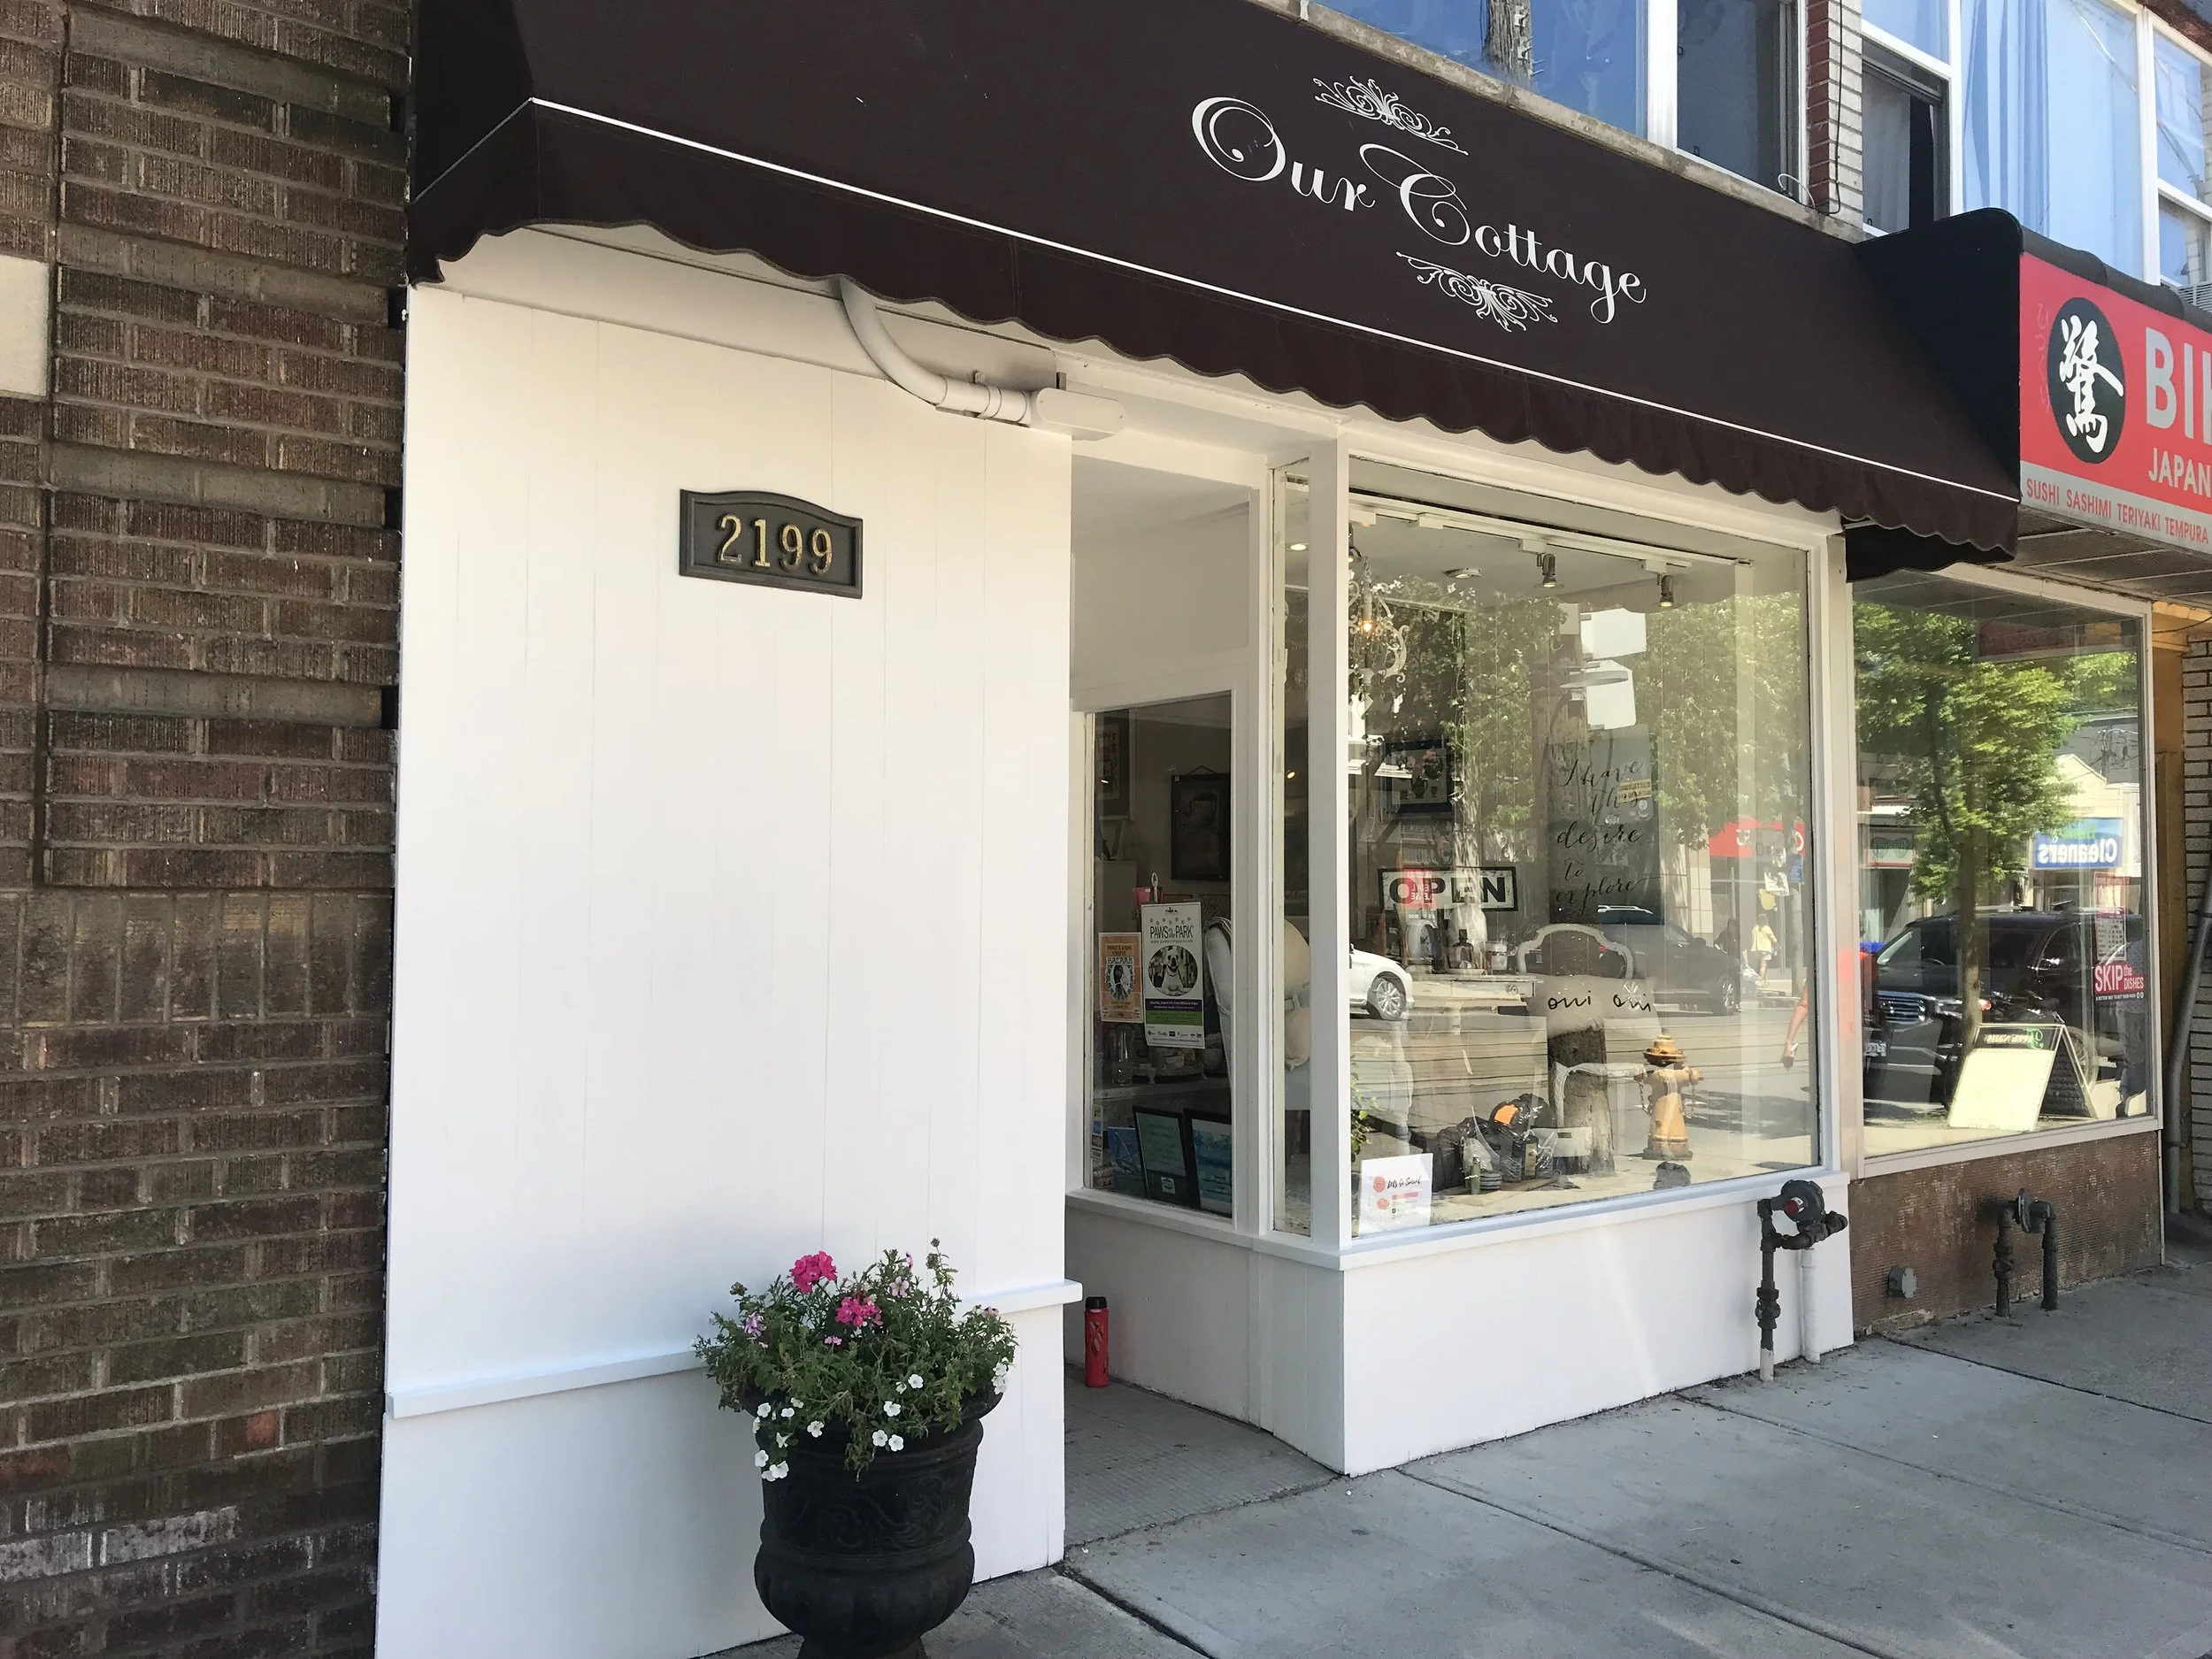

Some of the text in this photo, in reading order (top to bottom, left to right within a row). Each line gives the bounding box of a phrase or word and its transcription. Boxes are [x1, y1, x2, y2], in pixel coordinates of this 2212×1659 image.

[1192, 96, 1647, 324] Our Cottage
[2026, 478, 2209, 544] SUSHI SASHIMI TERIYAKI TEMPURA
[717, 513, 833, 576] 2199
[1580, 761, 1643, 787] have
[1556, 821, 1644, 852] desire
[1388, 877, 1507, 904] OPEN
[1150, 926, 1169, 938] PAWS
[1176, 925, 1194, 938] PARK
[2095, 964, 2124, 992] SKIP
[2124, 964, 2132, 977] the
[2124, 977, 2144, 990] DISHES
